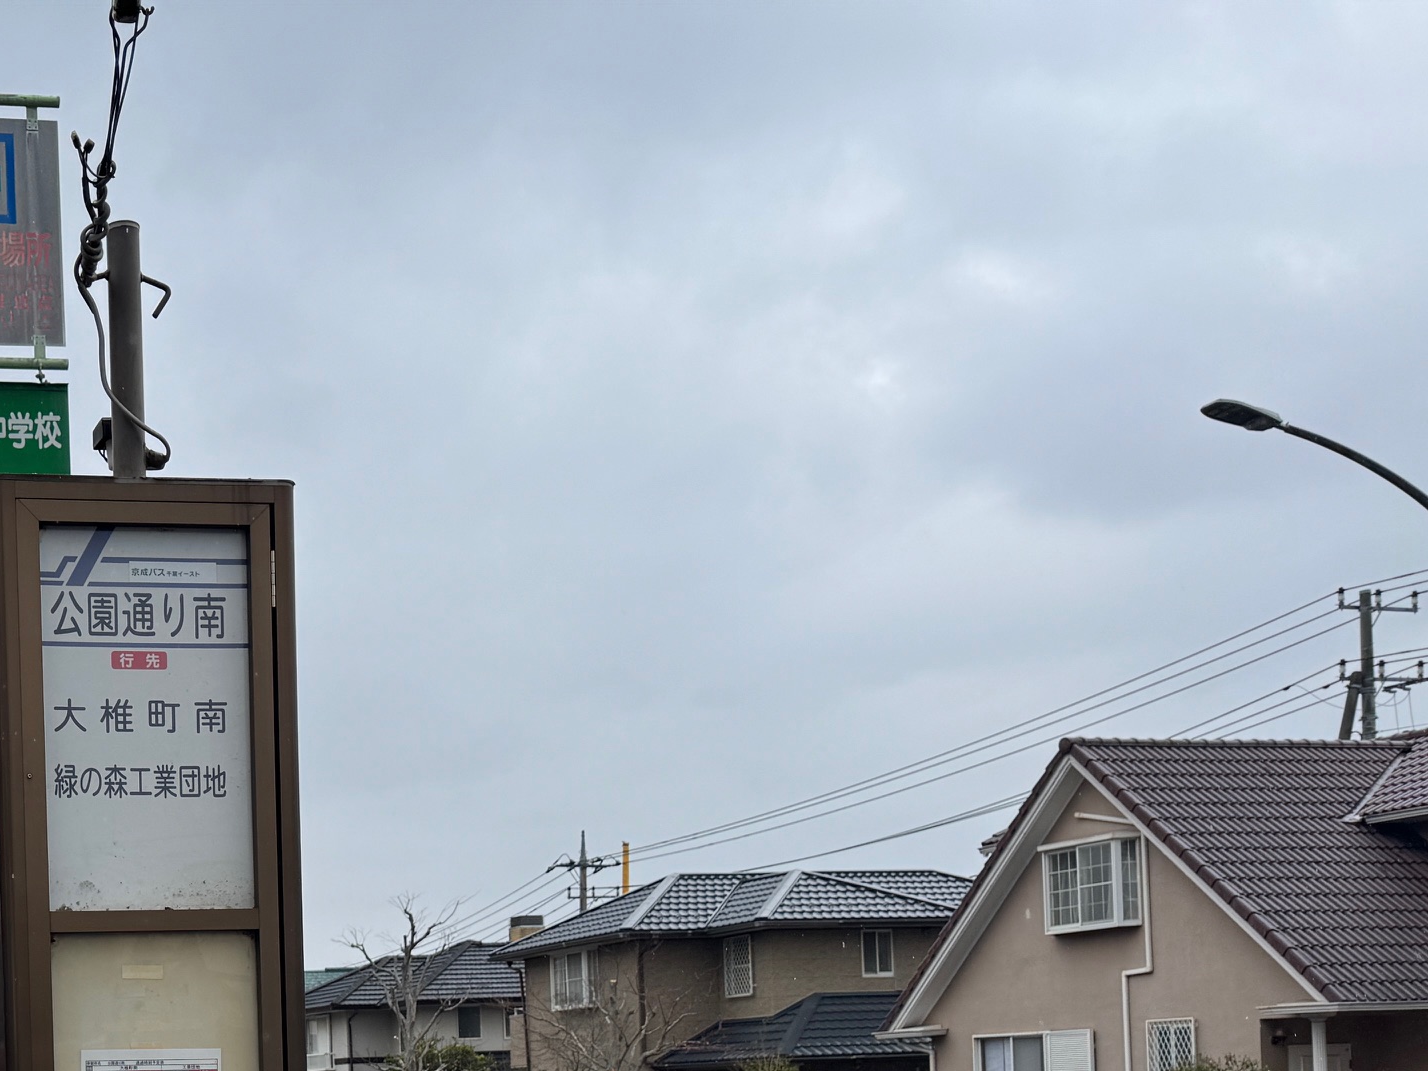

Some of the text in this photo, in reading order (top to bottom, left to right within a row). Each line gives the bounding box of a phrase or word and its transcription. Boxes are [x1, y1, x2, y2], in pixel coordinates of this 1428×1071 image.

[50, 590, 227, 639] 公園通り南
[119, 653, 161, 669] 行先
[53, 698, 228, 734] 大椎町南
[54, 763, 227, 799] 緑の森工業団地
